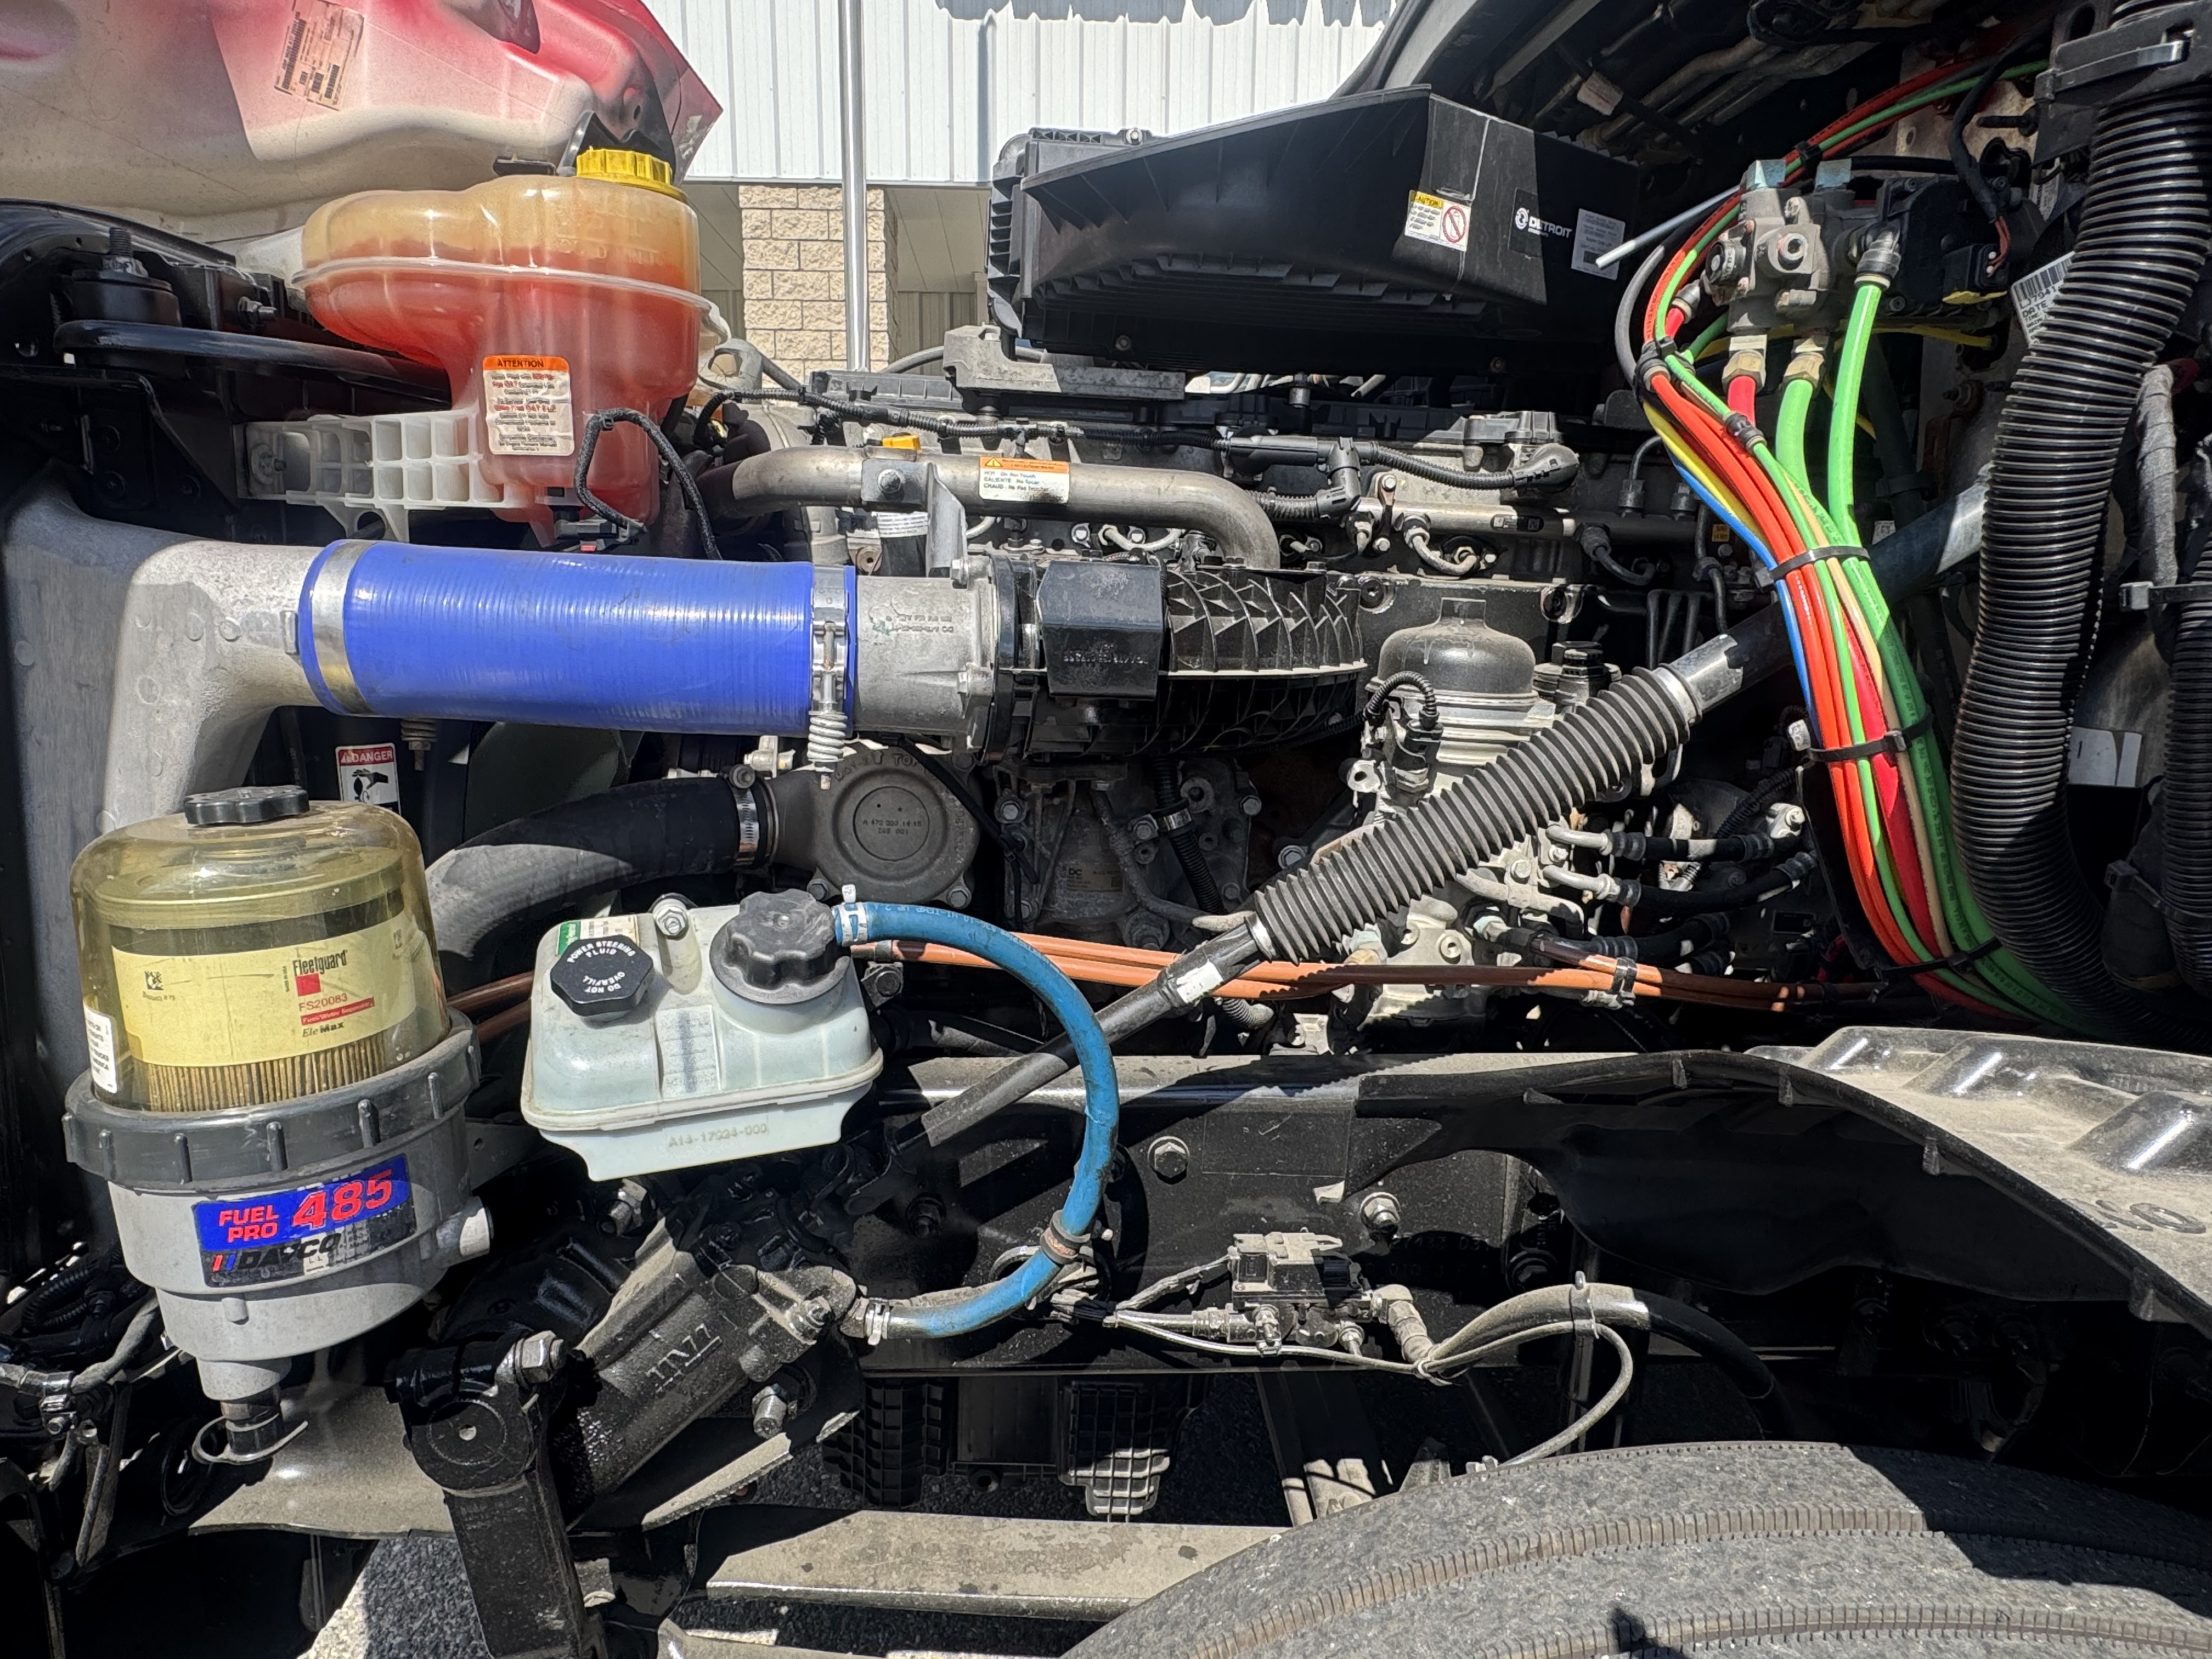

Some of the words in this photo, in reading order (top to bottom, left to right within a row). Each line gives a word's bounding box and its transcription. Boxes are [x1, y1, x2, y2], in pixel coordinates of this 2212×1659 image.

[497, 359, 545, 368] ATTENTION
[352, 750, 393, 763] DANGER
[566, 943, 595, 963] POWER
[596, 940, 636, 957] STEERING
[585, 948, 617, 958] FLUID
[292, 949, 347, 977] Fleetguard
[582, 970, 626, 986] OVERFILL
[607, 983, 623, 992] DO
[298, 992, 348, 1012] FS20083
[218, 1204, 280, 1227] FUEL
[291, 1169, 393, 1231] 485
[227, 1222, 279, 1244] PRO
